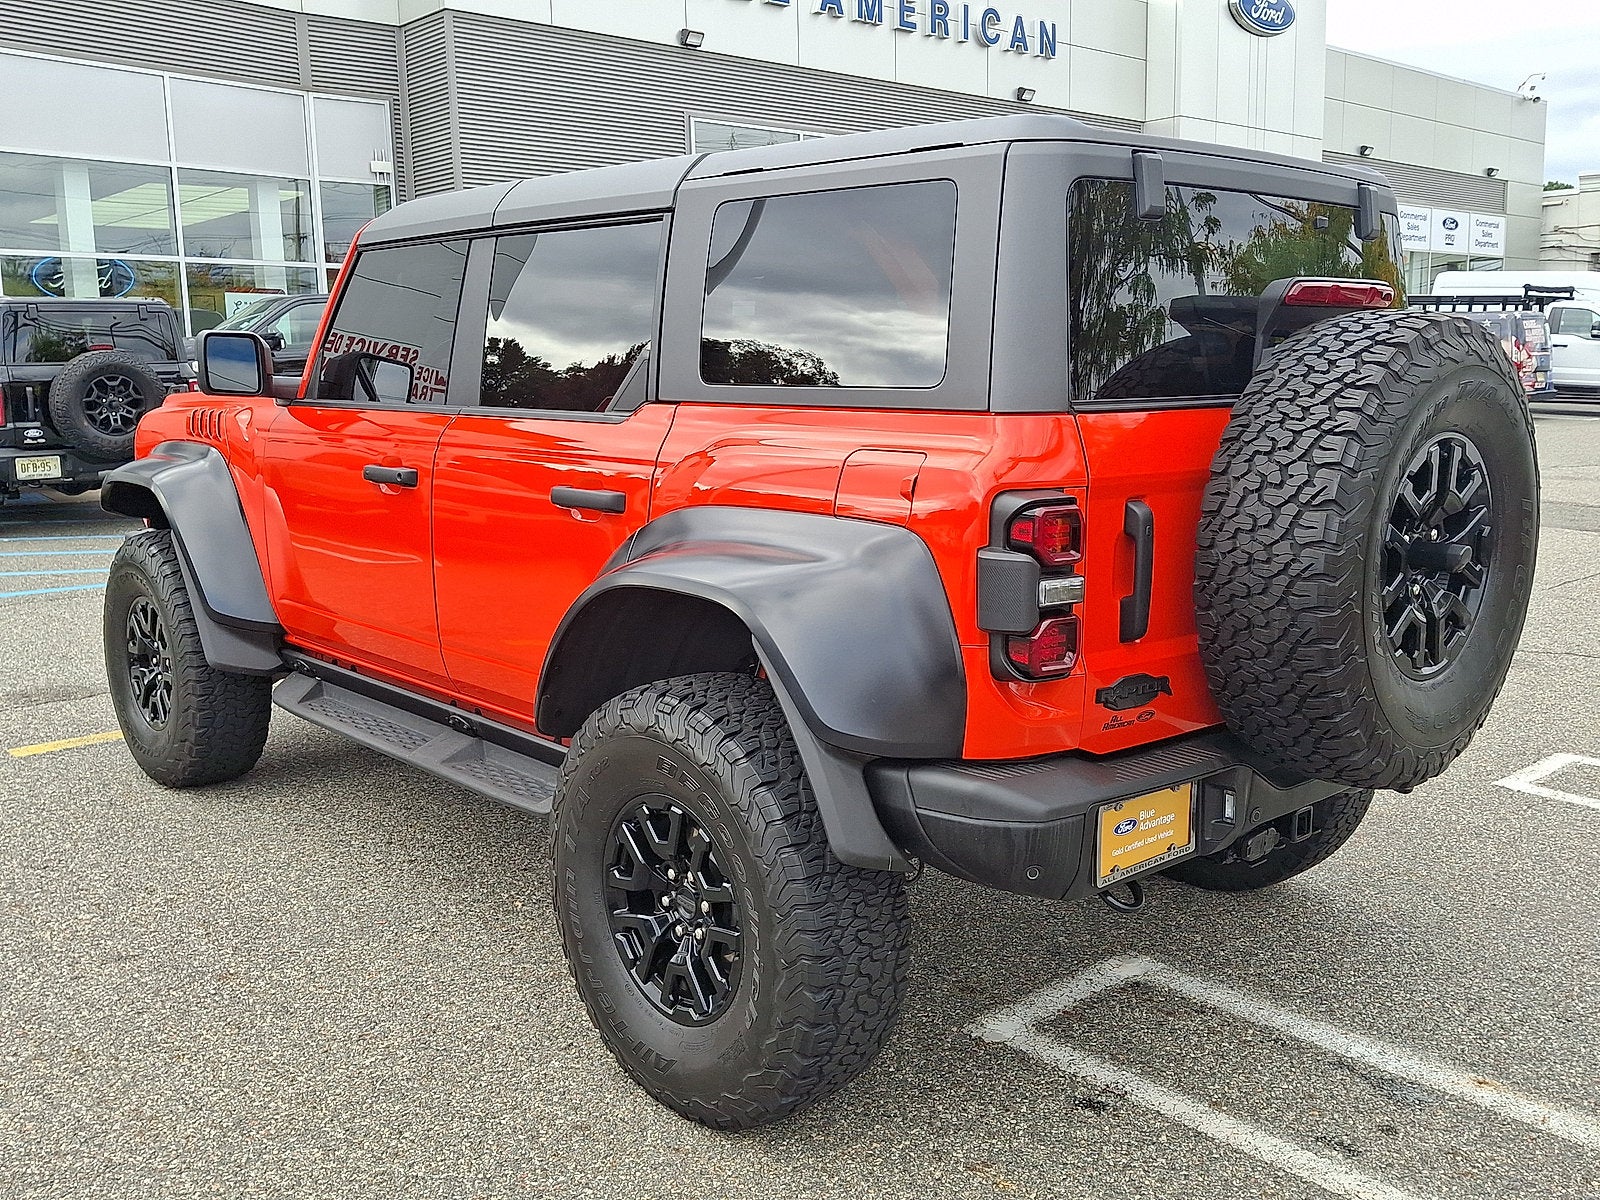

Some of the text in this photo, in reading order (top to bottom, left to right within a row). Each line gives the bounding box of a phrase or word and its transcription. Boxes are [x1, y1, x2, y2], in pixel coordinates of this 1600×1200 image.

[1251, 0, 1286, 25] Ford
[1400, 210, 1428, 222] Commercial
[1407, 222, 1420, 231] Sales
[1475, 219, 1500, 229] Commercial
[1445, 233, 1456, 242] PRO
[1481, 230, 1493, 239] Sales
[1474, 239, 1499, 249] Department
[1095, 675, 1172, 706] RAPTOR
[1139, 809, 1156, 821] Blue
[1116, 819, 1135, 834] Ford
[1139, 813, 1175, 831] Advantage
[1111, 829, 1174, 857] Gold Certified Used Vehicle
[1100, 846, 1191, 886] ALL AMERICAN FORD
